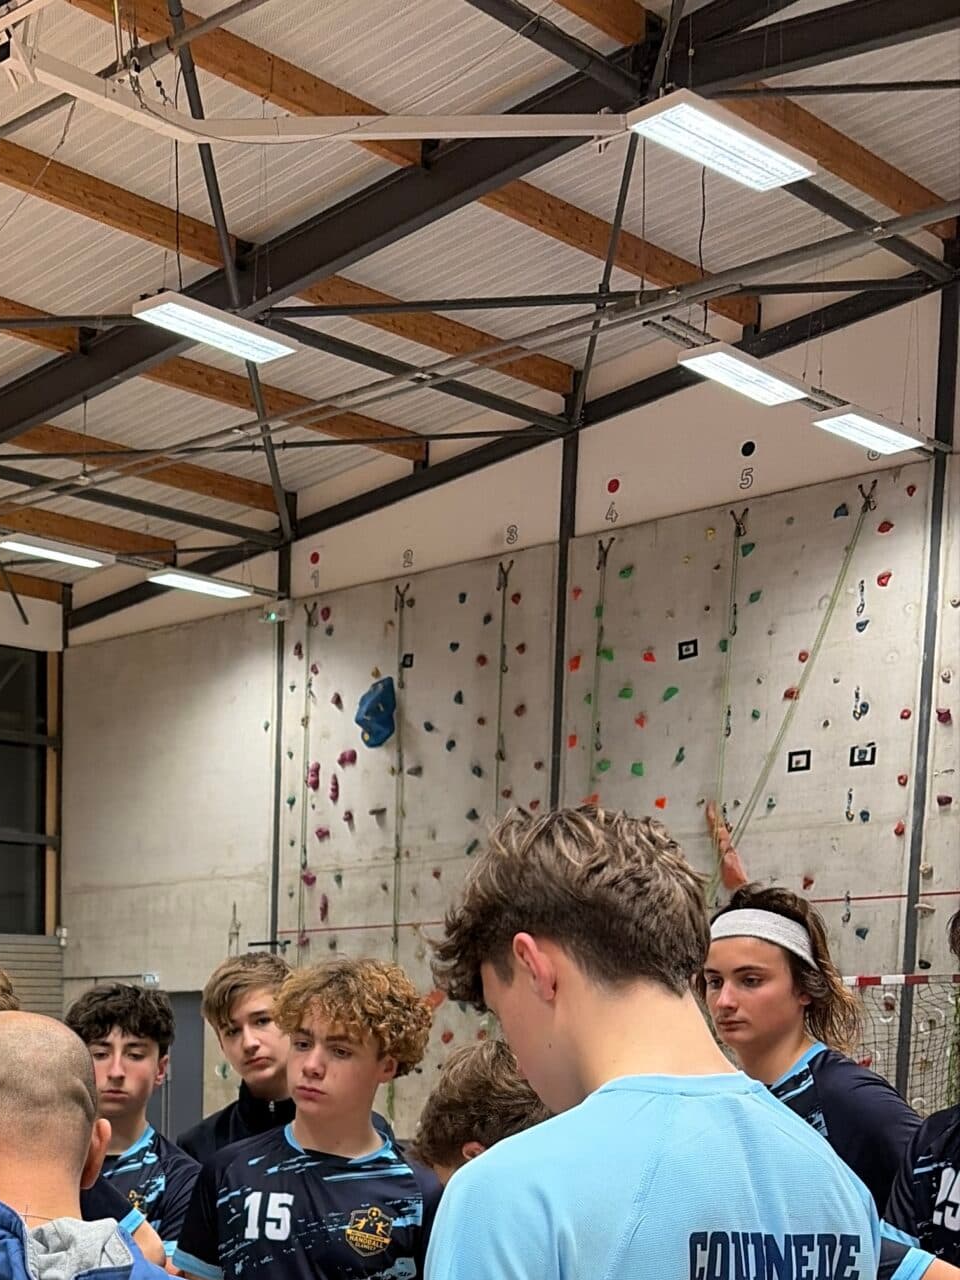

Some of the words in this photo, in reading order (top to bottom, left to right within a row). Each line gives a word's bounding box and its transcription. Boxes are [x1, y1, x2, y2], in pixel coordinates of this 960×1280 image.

[739, 467, 754, 490] 5
[605, 501, 619, 523] 4
[506, 524, 518, 545] 3
[403, 549, 414, 568] 2
[244, 1191, 294, 1241] 15
